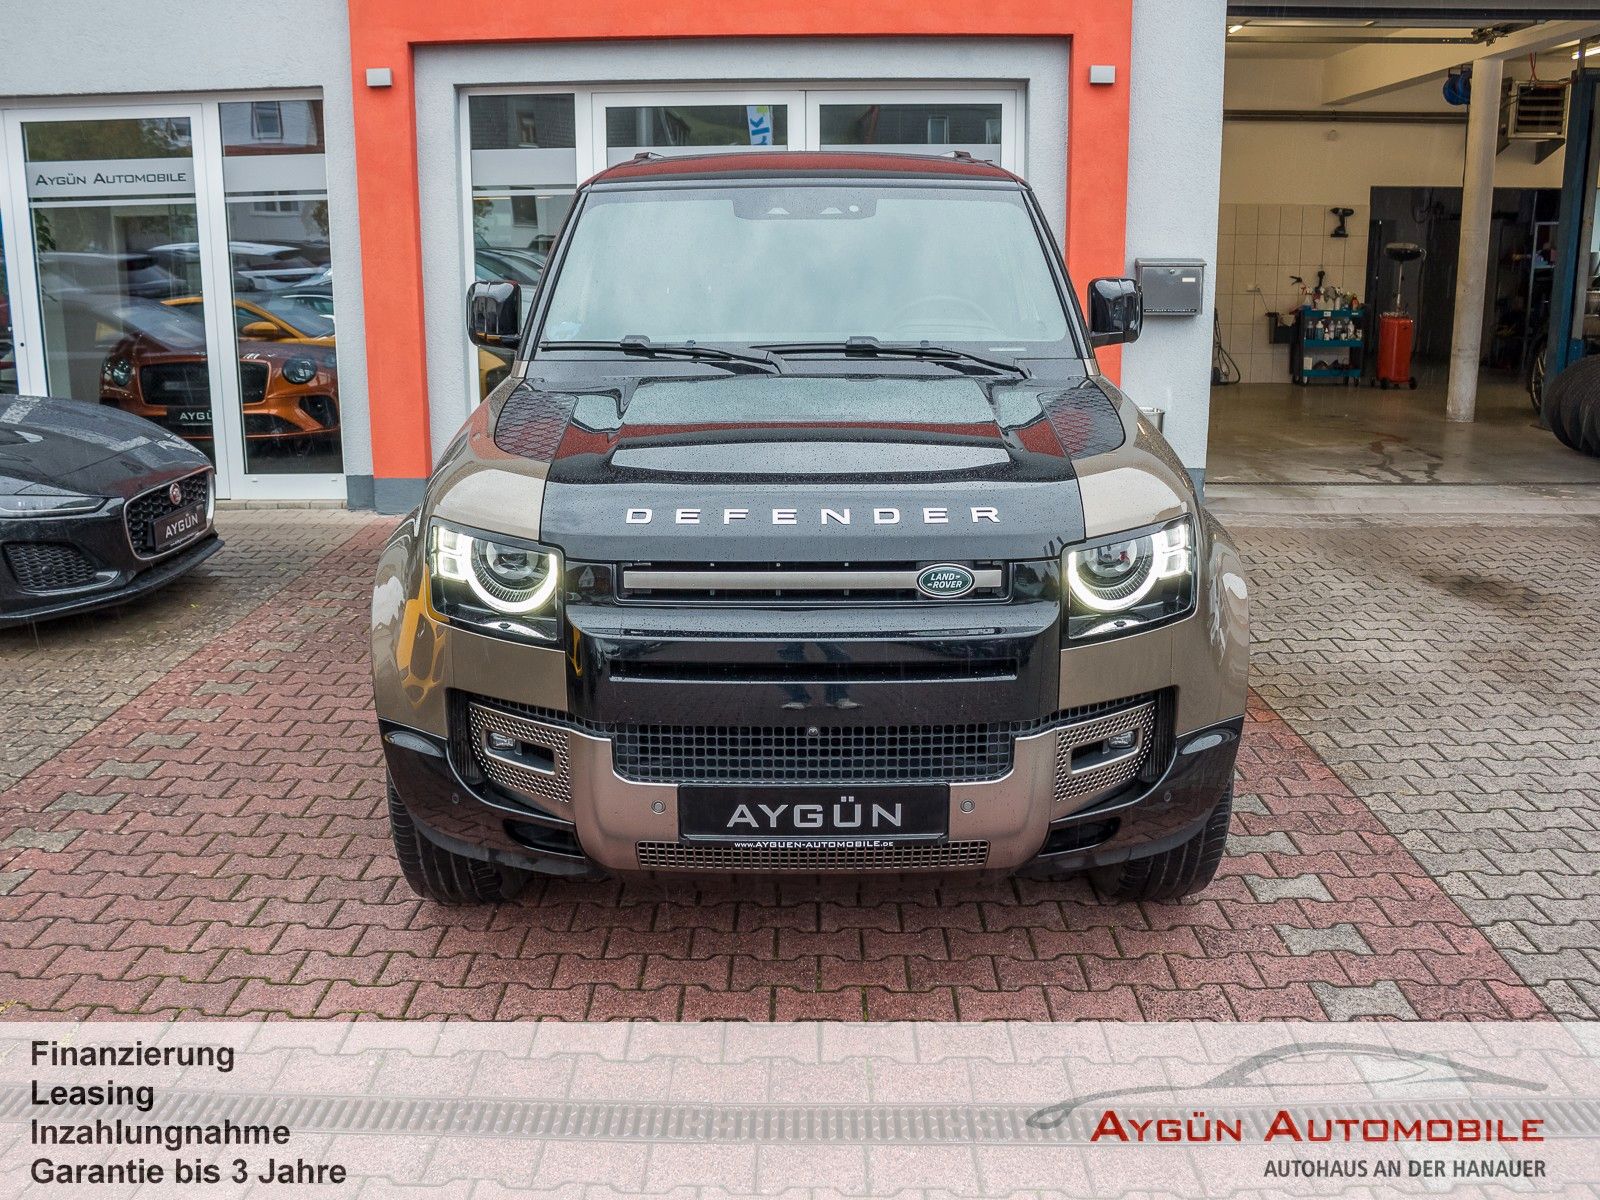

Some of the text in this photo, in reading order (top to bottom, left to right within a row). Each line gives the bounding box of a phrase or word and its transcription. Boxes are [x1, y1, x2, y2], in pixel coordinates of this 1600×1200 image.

[35, 172, 187, 186] AYGÜN AUTOMOBILE
[625, 507, 1001, 525] DEFENDER
[165, 513, 199, 539] AYGÜN
[930, 573, 955, 581] LAND
[932, 581, 963, 589] ROVER
[726, 796, 902, 828] AYGÜN
